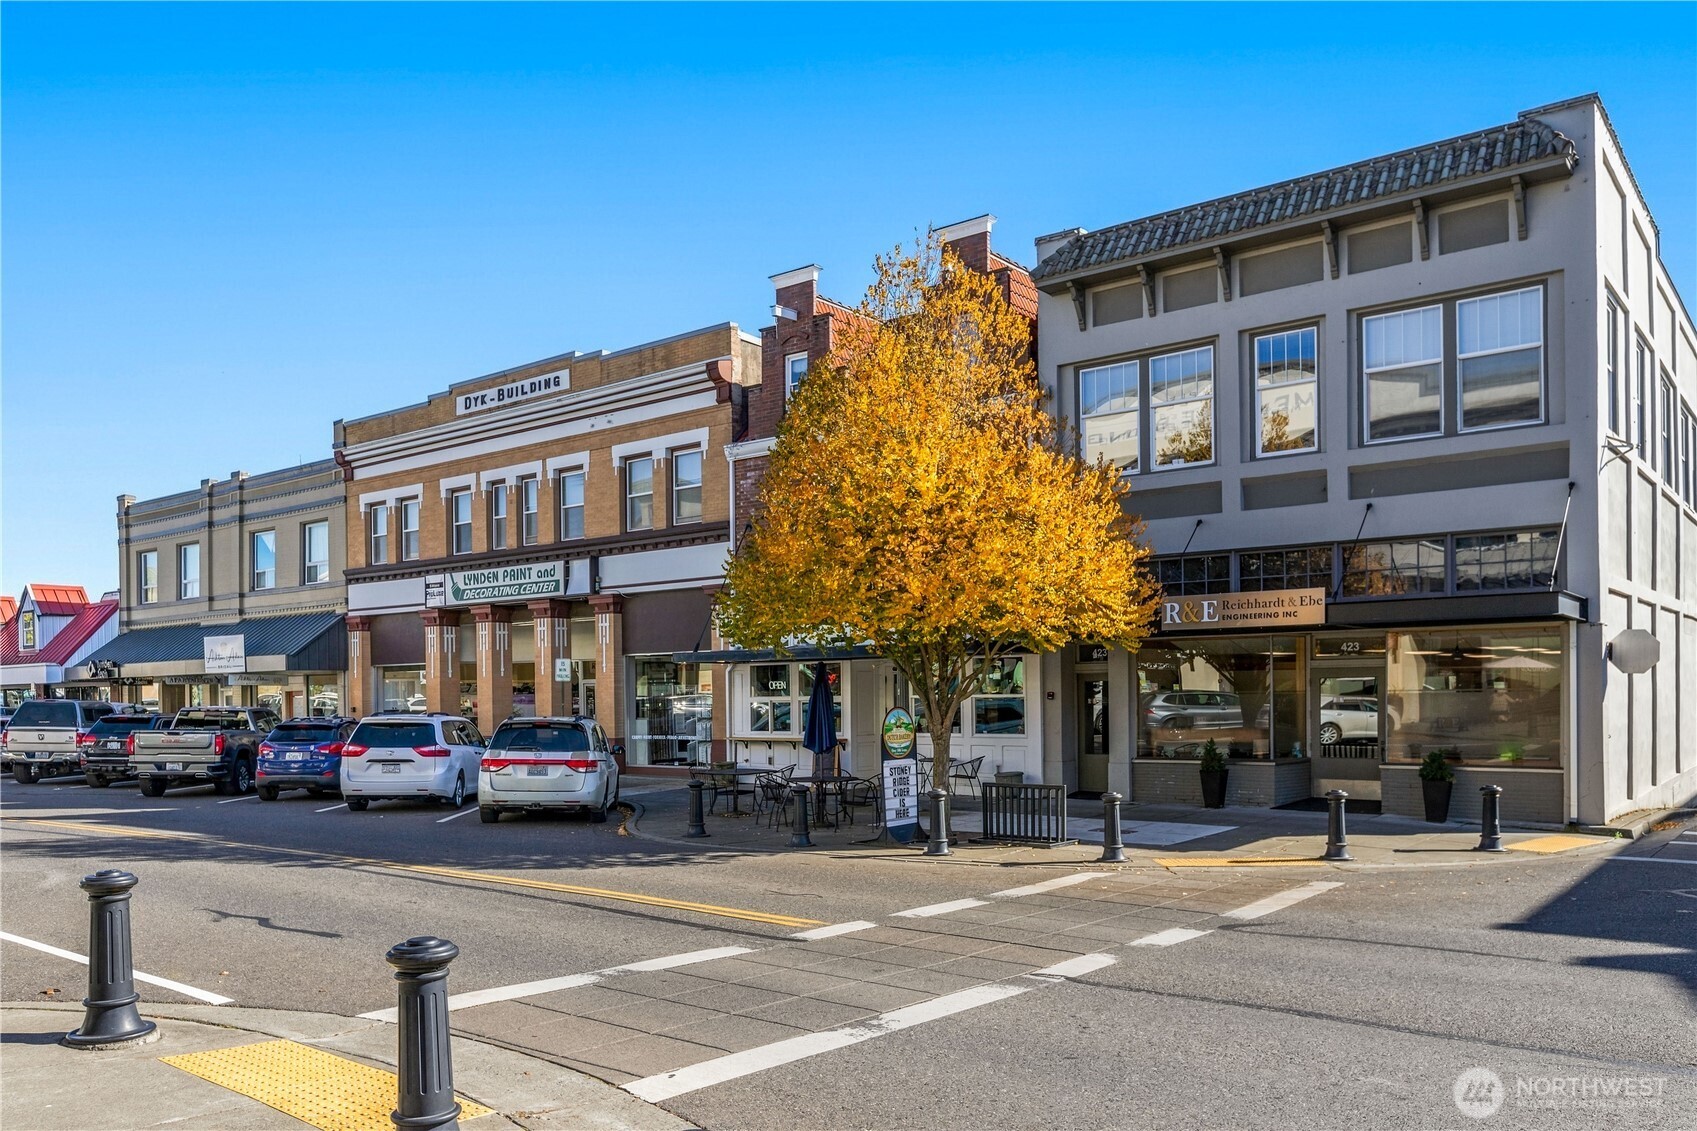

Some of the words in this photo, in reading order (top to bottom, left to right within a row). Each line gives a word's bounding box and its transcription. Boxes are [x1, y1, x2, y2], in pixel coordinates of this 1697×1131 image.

[463, 570, 499, 586] LYNDEN
[502, 567, 533, 582] PAINT
[537, 565, 556, 579] and
[463, 585, 518, 600] DECORATING
[520, 582, 556, 594] CENTER
[1222, 597, 1285, 610] Reichhardt
[1287, 597, 1298, 608] &
[1300, 595, 1323, 606] Ebe
[1163, 600, 1219, 624] R&E
[1222, 611, 1279, 621] ENGINEERING
[1282, 610, 1298, 618] INC
[1341, 642, 1360, 652] 423
[768, 681, 787, 690] OPEN
[889, 765, 911, 777] STONEY
[892, 776, 910, 787] RIDGE
[892, 787, 910, 798] CIDER
[899, 798, 906, 808] IS
[895, 808, 910, 819] HERE
